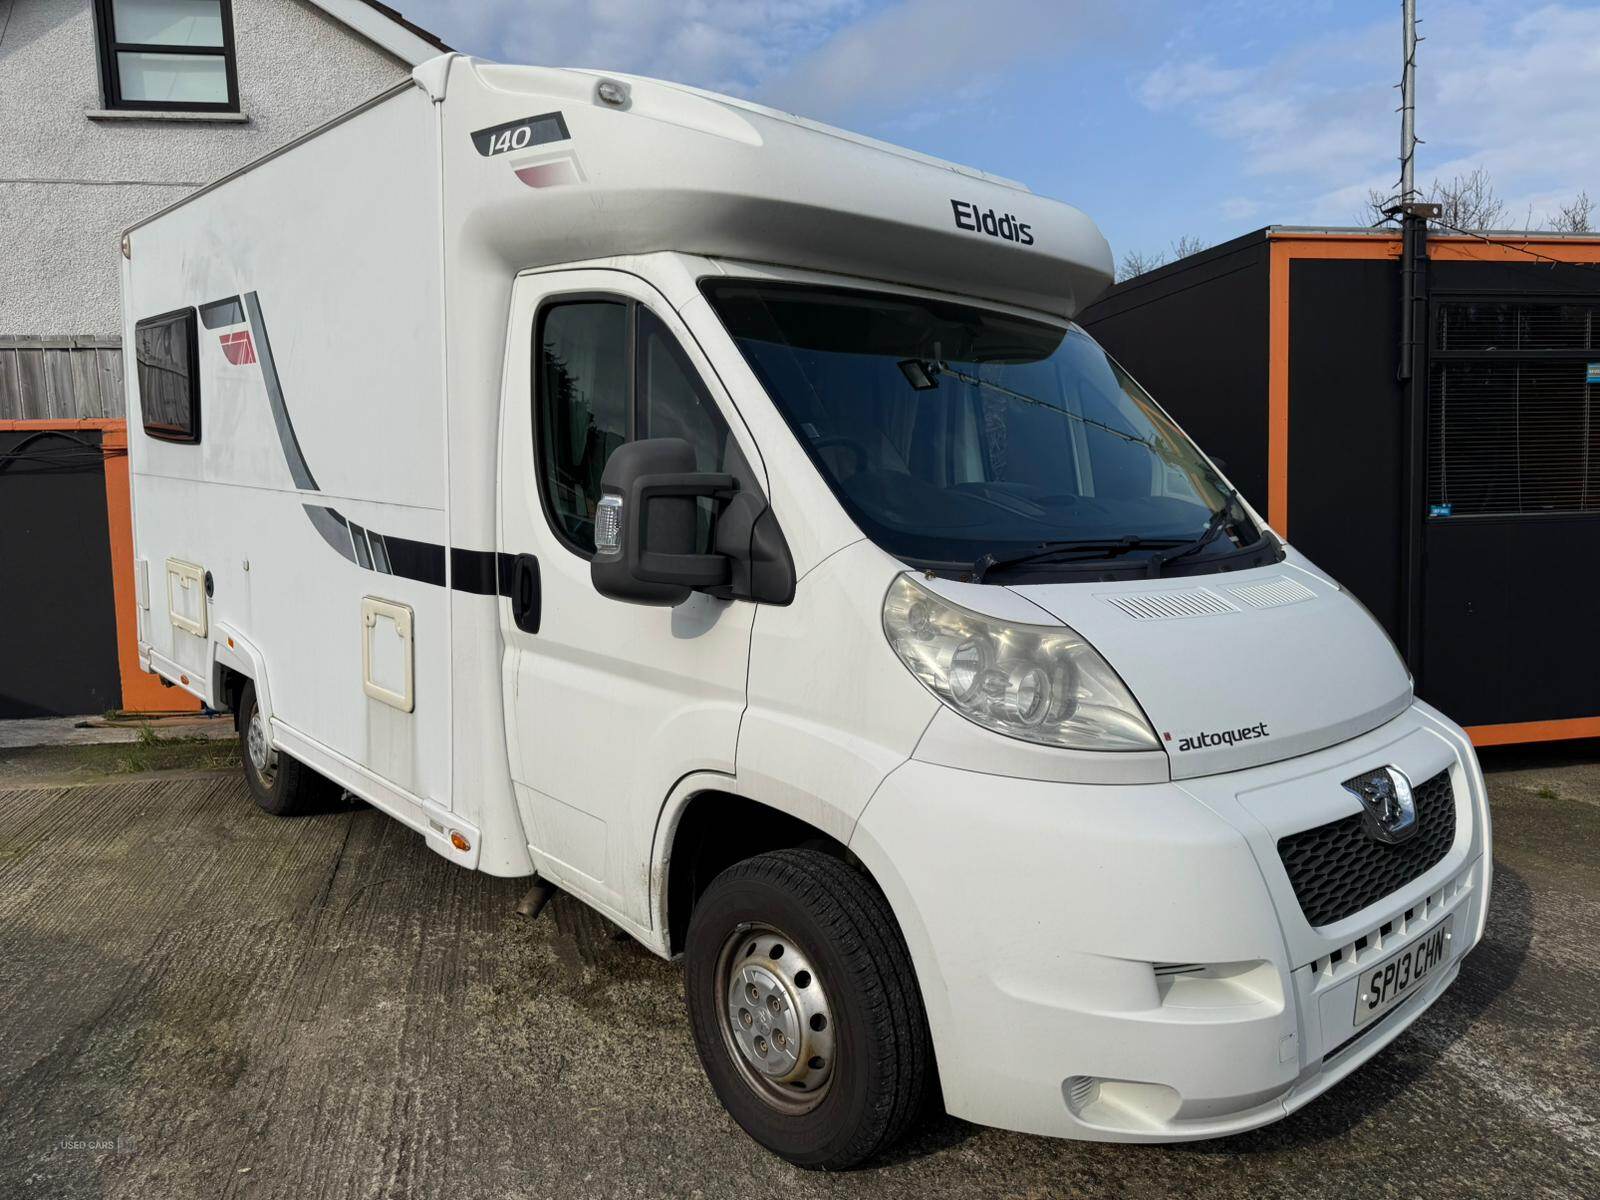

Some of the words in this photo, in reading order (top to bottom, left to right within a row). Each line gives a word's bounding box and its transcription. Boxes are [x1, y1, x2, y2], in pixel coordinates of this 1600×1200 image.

[488, 126, 532, 156] 140
[950, 199, 1034, 246] Elddis
[1178, 722, 1270, 752] autoquest
[1368, 952, 1412, 1010] SP13
[1414, 926, 1446, 979] CHN
